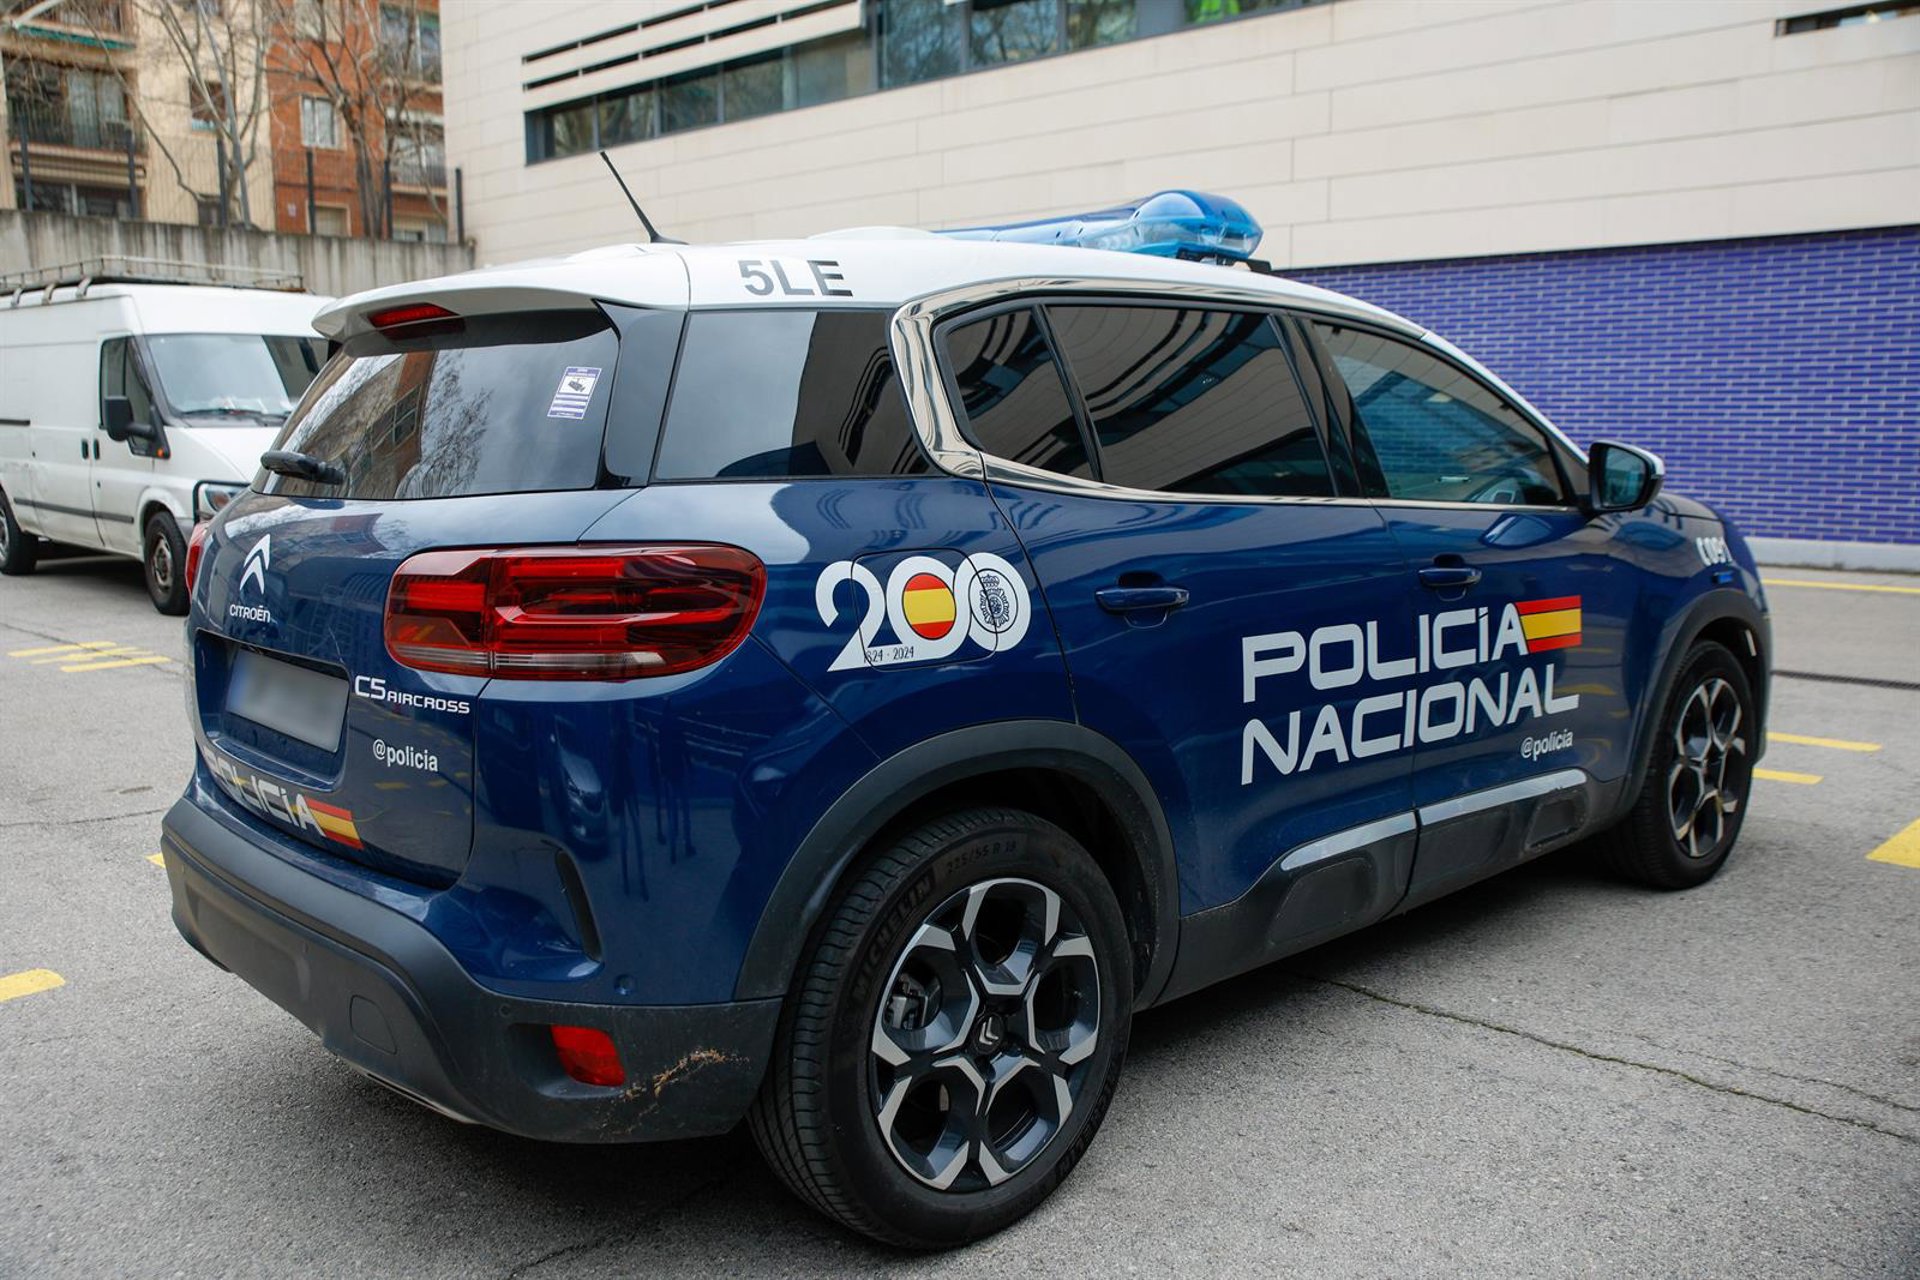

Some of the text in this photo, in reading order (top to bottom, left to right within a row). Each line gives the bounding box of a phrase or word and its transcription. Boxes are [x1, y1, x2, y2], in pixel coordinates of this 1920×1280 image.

[738, 259, 853, 297] 5LE
[815, 552, 1032, 672] 200
[892, 645, 914, 660] 2024
[354, 675, 470, 714] C5 AIRCROSS
[1241, 663, 1580, 786] NACIONAL
[372, 739, 438, 772] @policia
[1520, 728, 1574, 761] @policia
[850, 872, 937, 1000] MICHELIN
